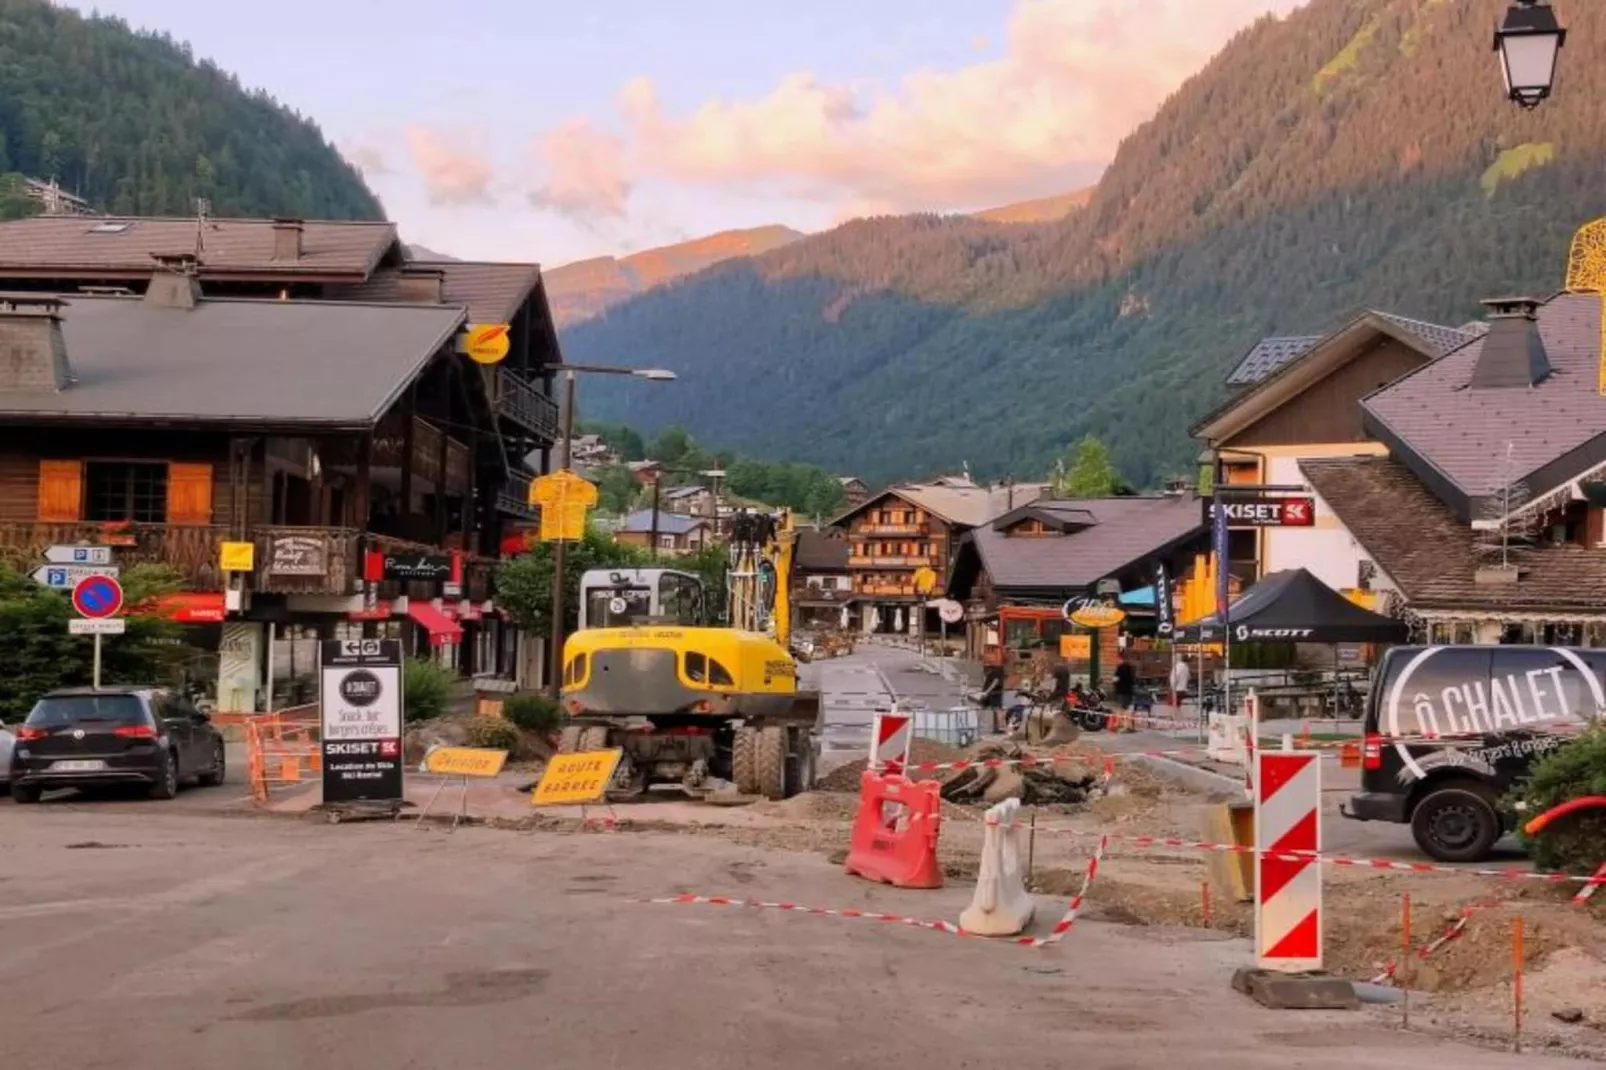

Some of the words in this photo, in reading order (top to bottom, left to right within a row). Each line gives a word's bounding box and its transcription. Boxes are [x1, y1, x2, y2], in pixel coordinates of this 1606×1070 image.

[1250, 628, 1314, 638] SCOTT
[1440, 666, 1570, 733] CHALET
[326, 742, 379, 755] SKISET
[557, 760, 604, 773] ROUTE
